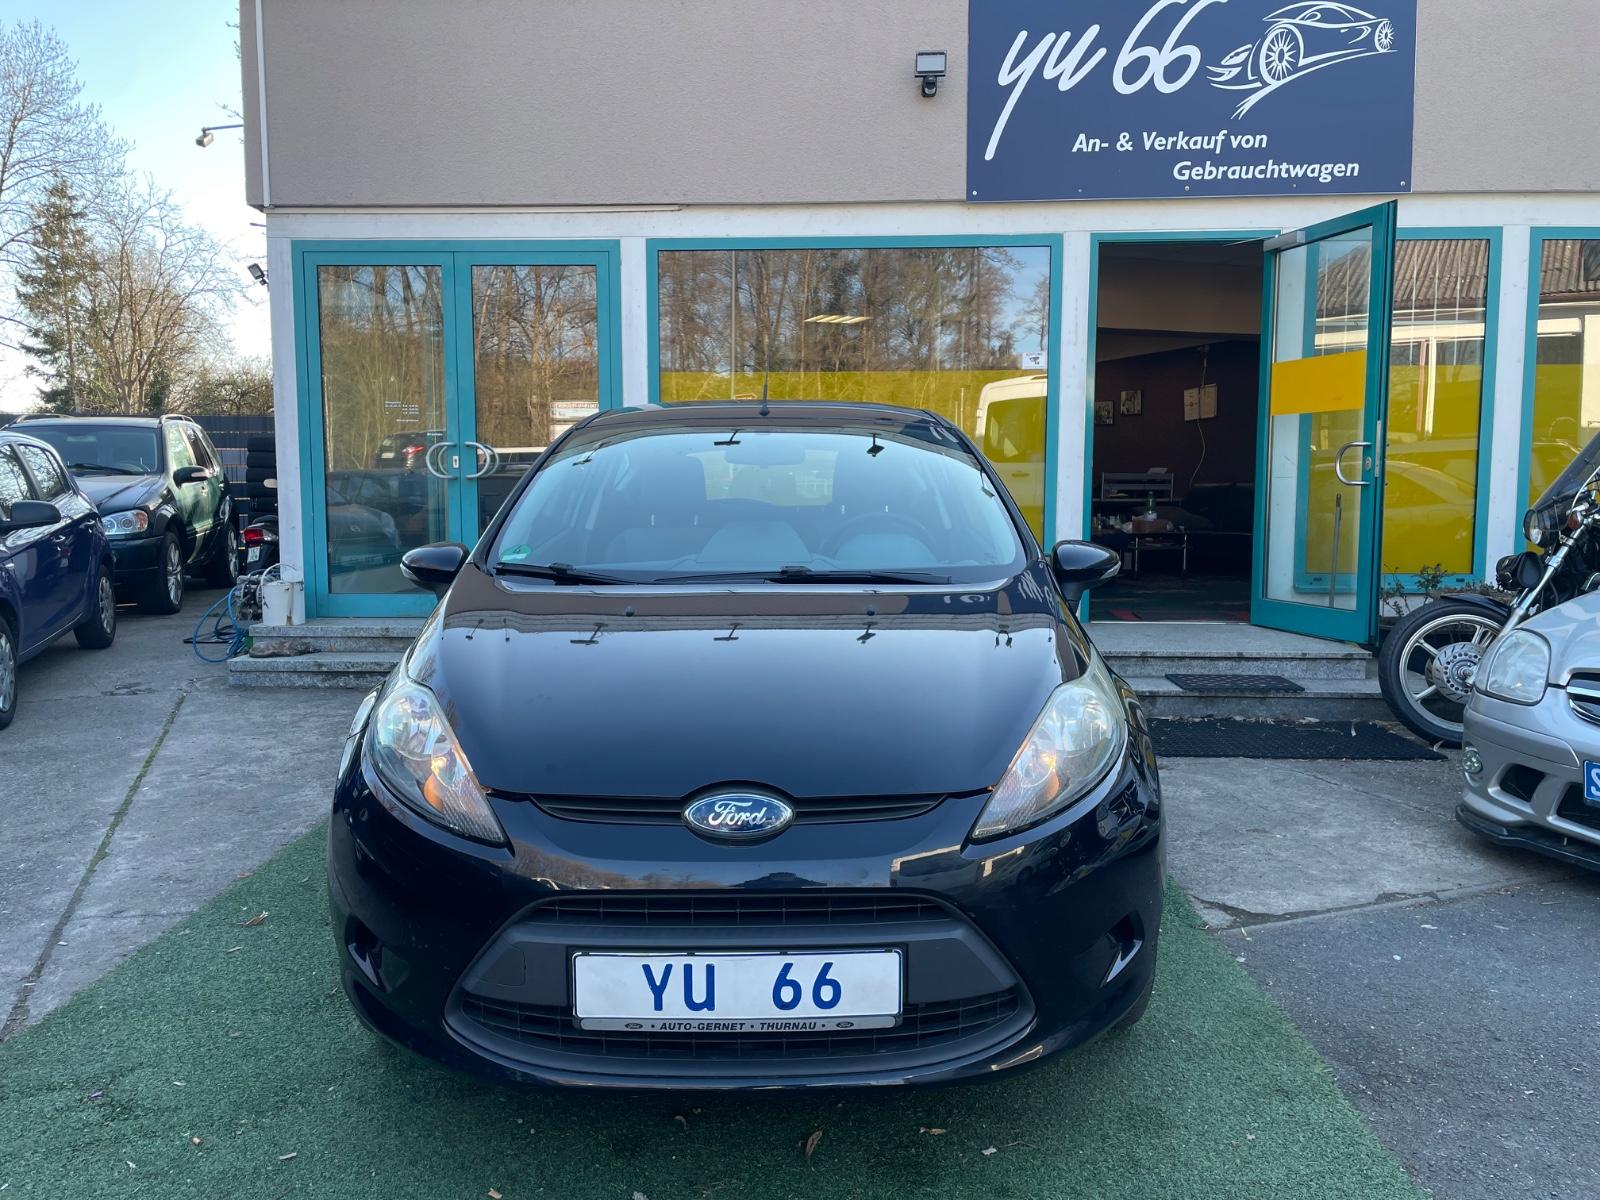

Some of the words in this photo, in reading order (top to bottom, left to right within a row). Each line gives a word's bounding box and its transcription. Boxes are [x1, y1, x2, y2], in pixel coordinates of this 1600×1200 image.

[1113, 0, 1228, 94] 66
[1072, 133, 1109, 152] An-
[1116, 131, 1133, 151] &
[1143, 130, 1228, 154] Verkauf
[1230, 134, 1267, 149] von
[1173, 160, 1360, 183] Gebrauchtwagen
[708, 801, 767, 825] Ford
[642, 963, 716, 1012] YU
[772, 962, 842, 1011] 66
[660, 1022, 746, 1031] AUTO-GERNET
[759, 1022, 817, 1031] THURNAU
